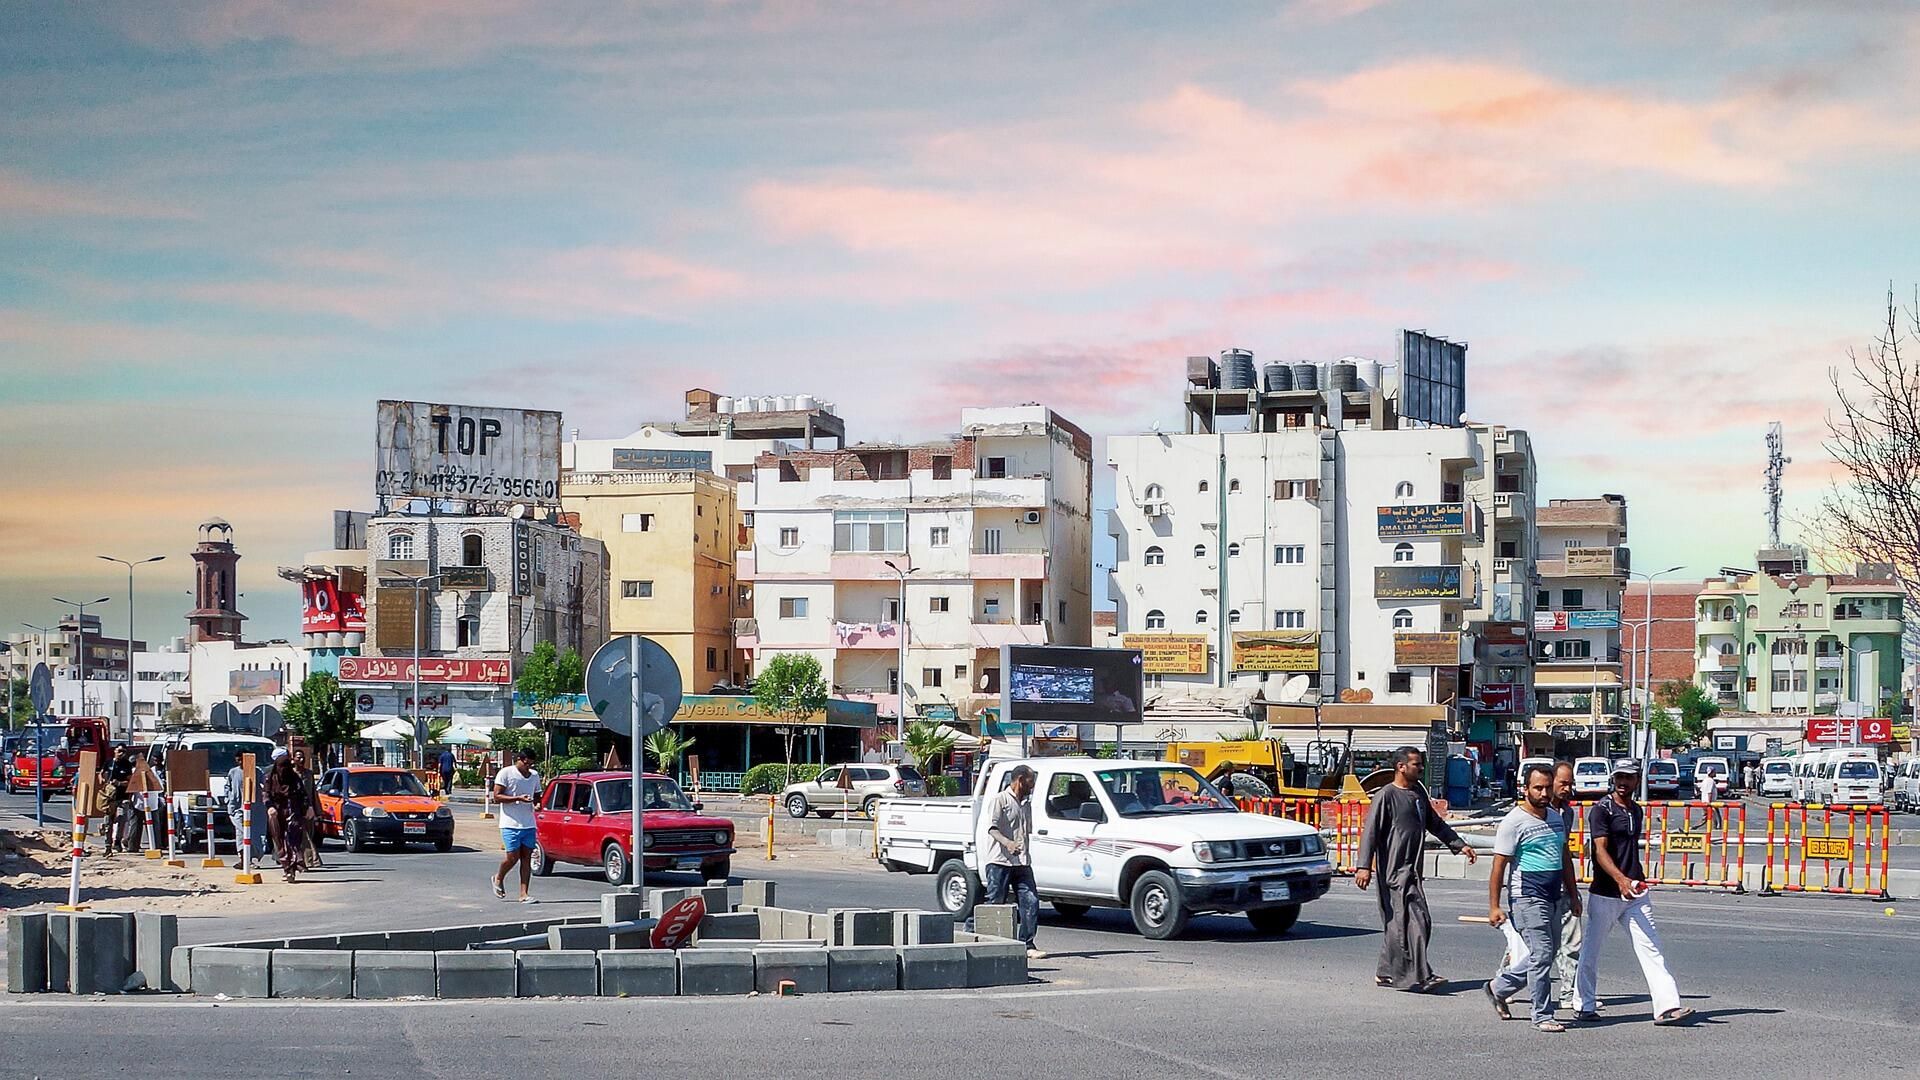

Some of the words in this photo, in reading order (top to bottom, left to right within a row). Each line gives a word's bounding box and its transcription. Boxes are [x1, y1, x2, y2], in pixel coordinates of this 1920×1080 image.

[432, 415, 501, 456] TOP
[1432, 504, 1462, 517] معامل
[519, 541, 528, 582] GOOD
[362, 660, 398, 679] فلافل
[405, 661, 469, 680] الزعيم
[477, 662, 508, 682] فول
[405, 693, 449, 711] الزعيم
[678, 703, 729, 718] ayeem
[661, 901, 698, 947] STOP
